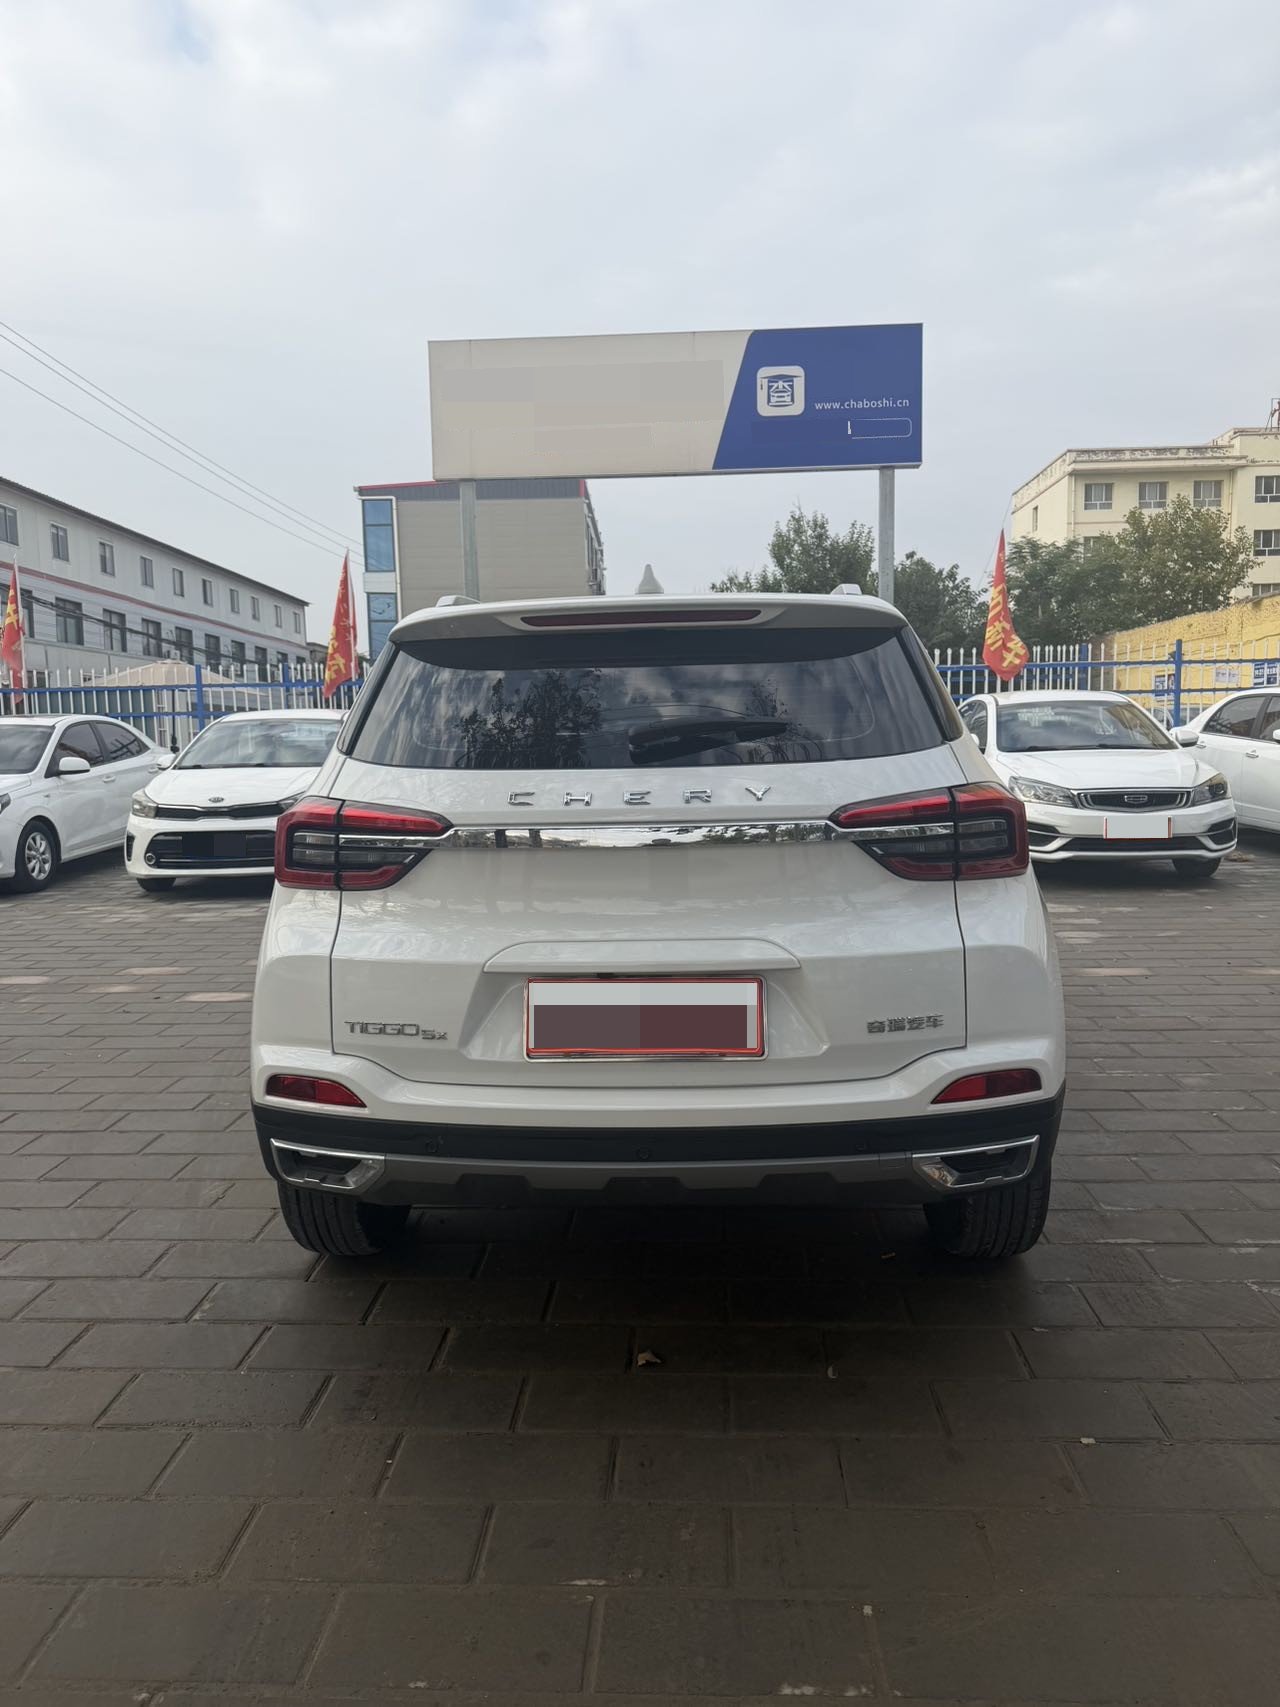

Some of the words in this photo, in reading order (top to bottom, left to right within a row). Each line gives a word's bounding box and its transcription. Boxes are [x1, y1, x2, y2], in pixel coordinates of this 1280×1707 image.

[815, 397, 909, 410] www.chaboshi.cn
[507, 784, 772, 807] CHERY
[344, 1021, 420, 1037] TIGGO
[867, 1014, 944, 1033] 奇瑞汽车
